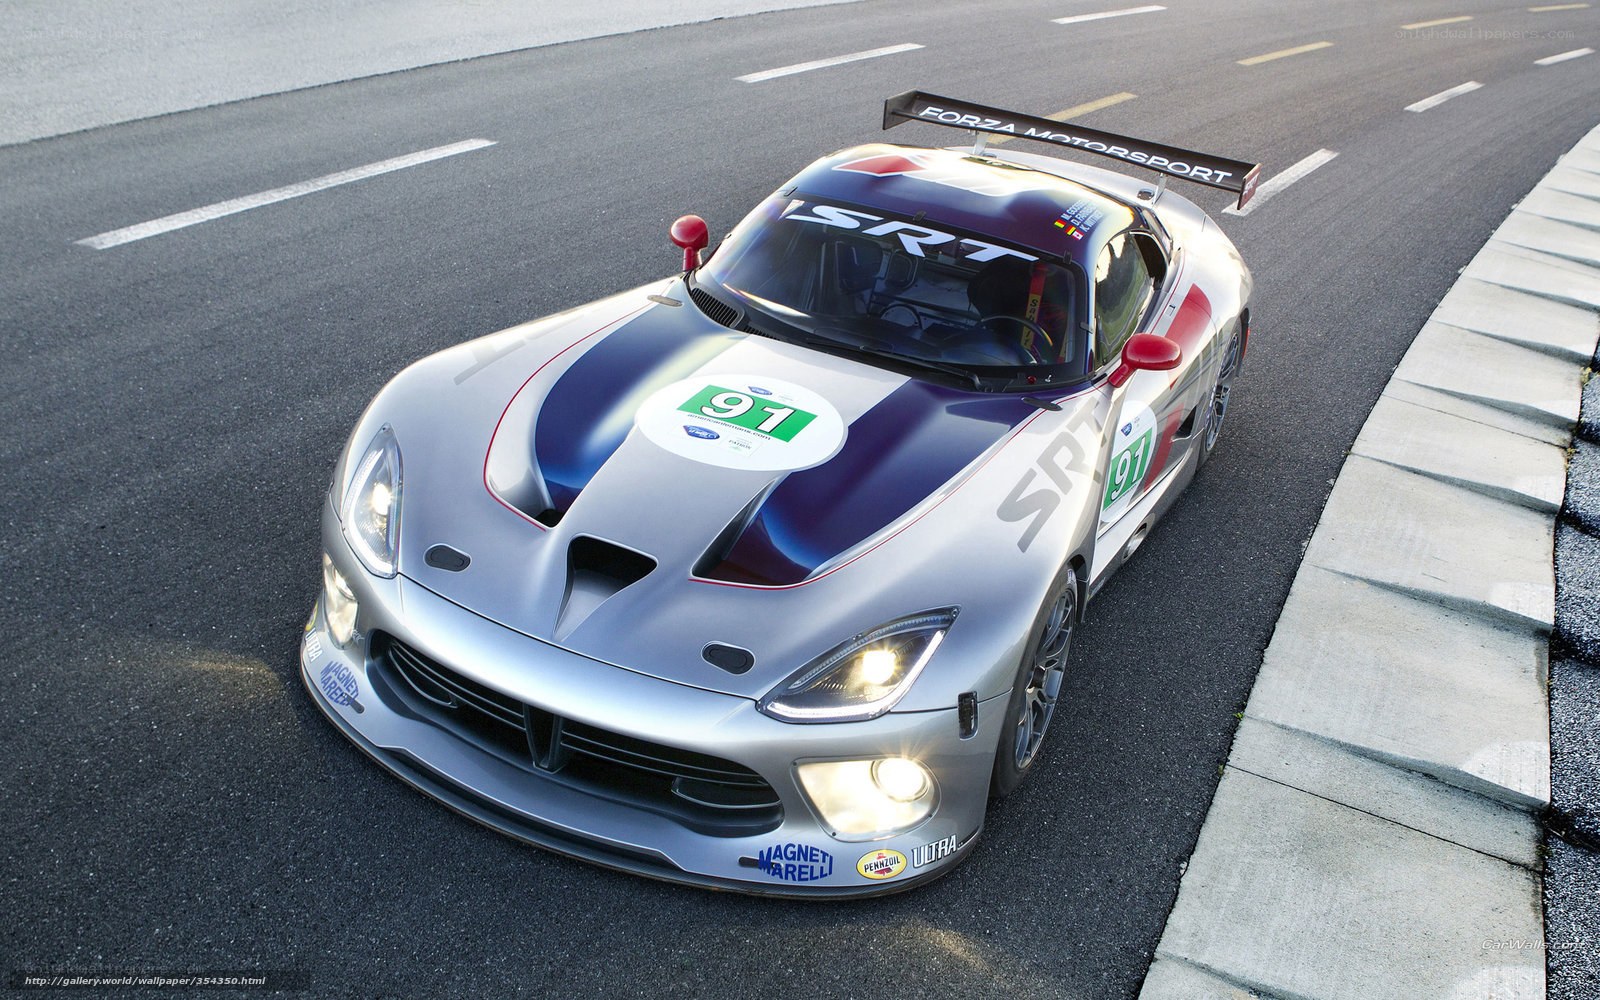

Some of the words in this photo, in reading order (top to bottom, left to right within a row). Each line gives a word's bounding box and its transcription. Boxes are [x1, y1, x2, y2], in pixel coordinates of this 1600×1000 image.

[918, 106, 1016, 133] FORZA
[1023, 126, 1233, 183] MOTORSPORT
[786, 203, 1040, 263] SRT
[700, 391, 798, 434] 91
[996, 396, 1107, 553] SRT
[1110, 436, 1147, 502] 91
[759, 843, 834, 870] MAGNETI
[759, 856, 834, 882] MARELLI
[863, 855, 901, 873] PENNZOIL
[912, 834, 957, 868] ULTRA
